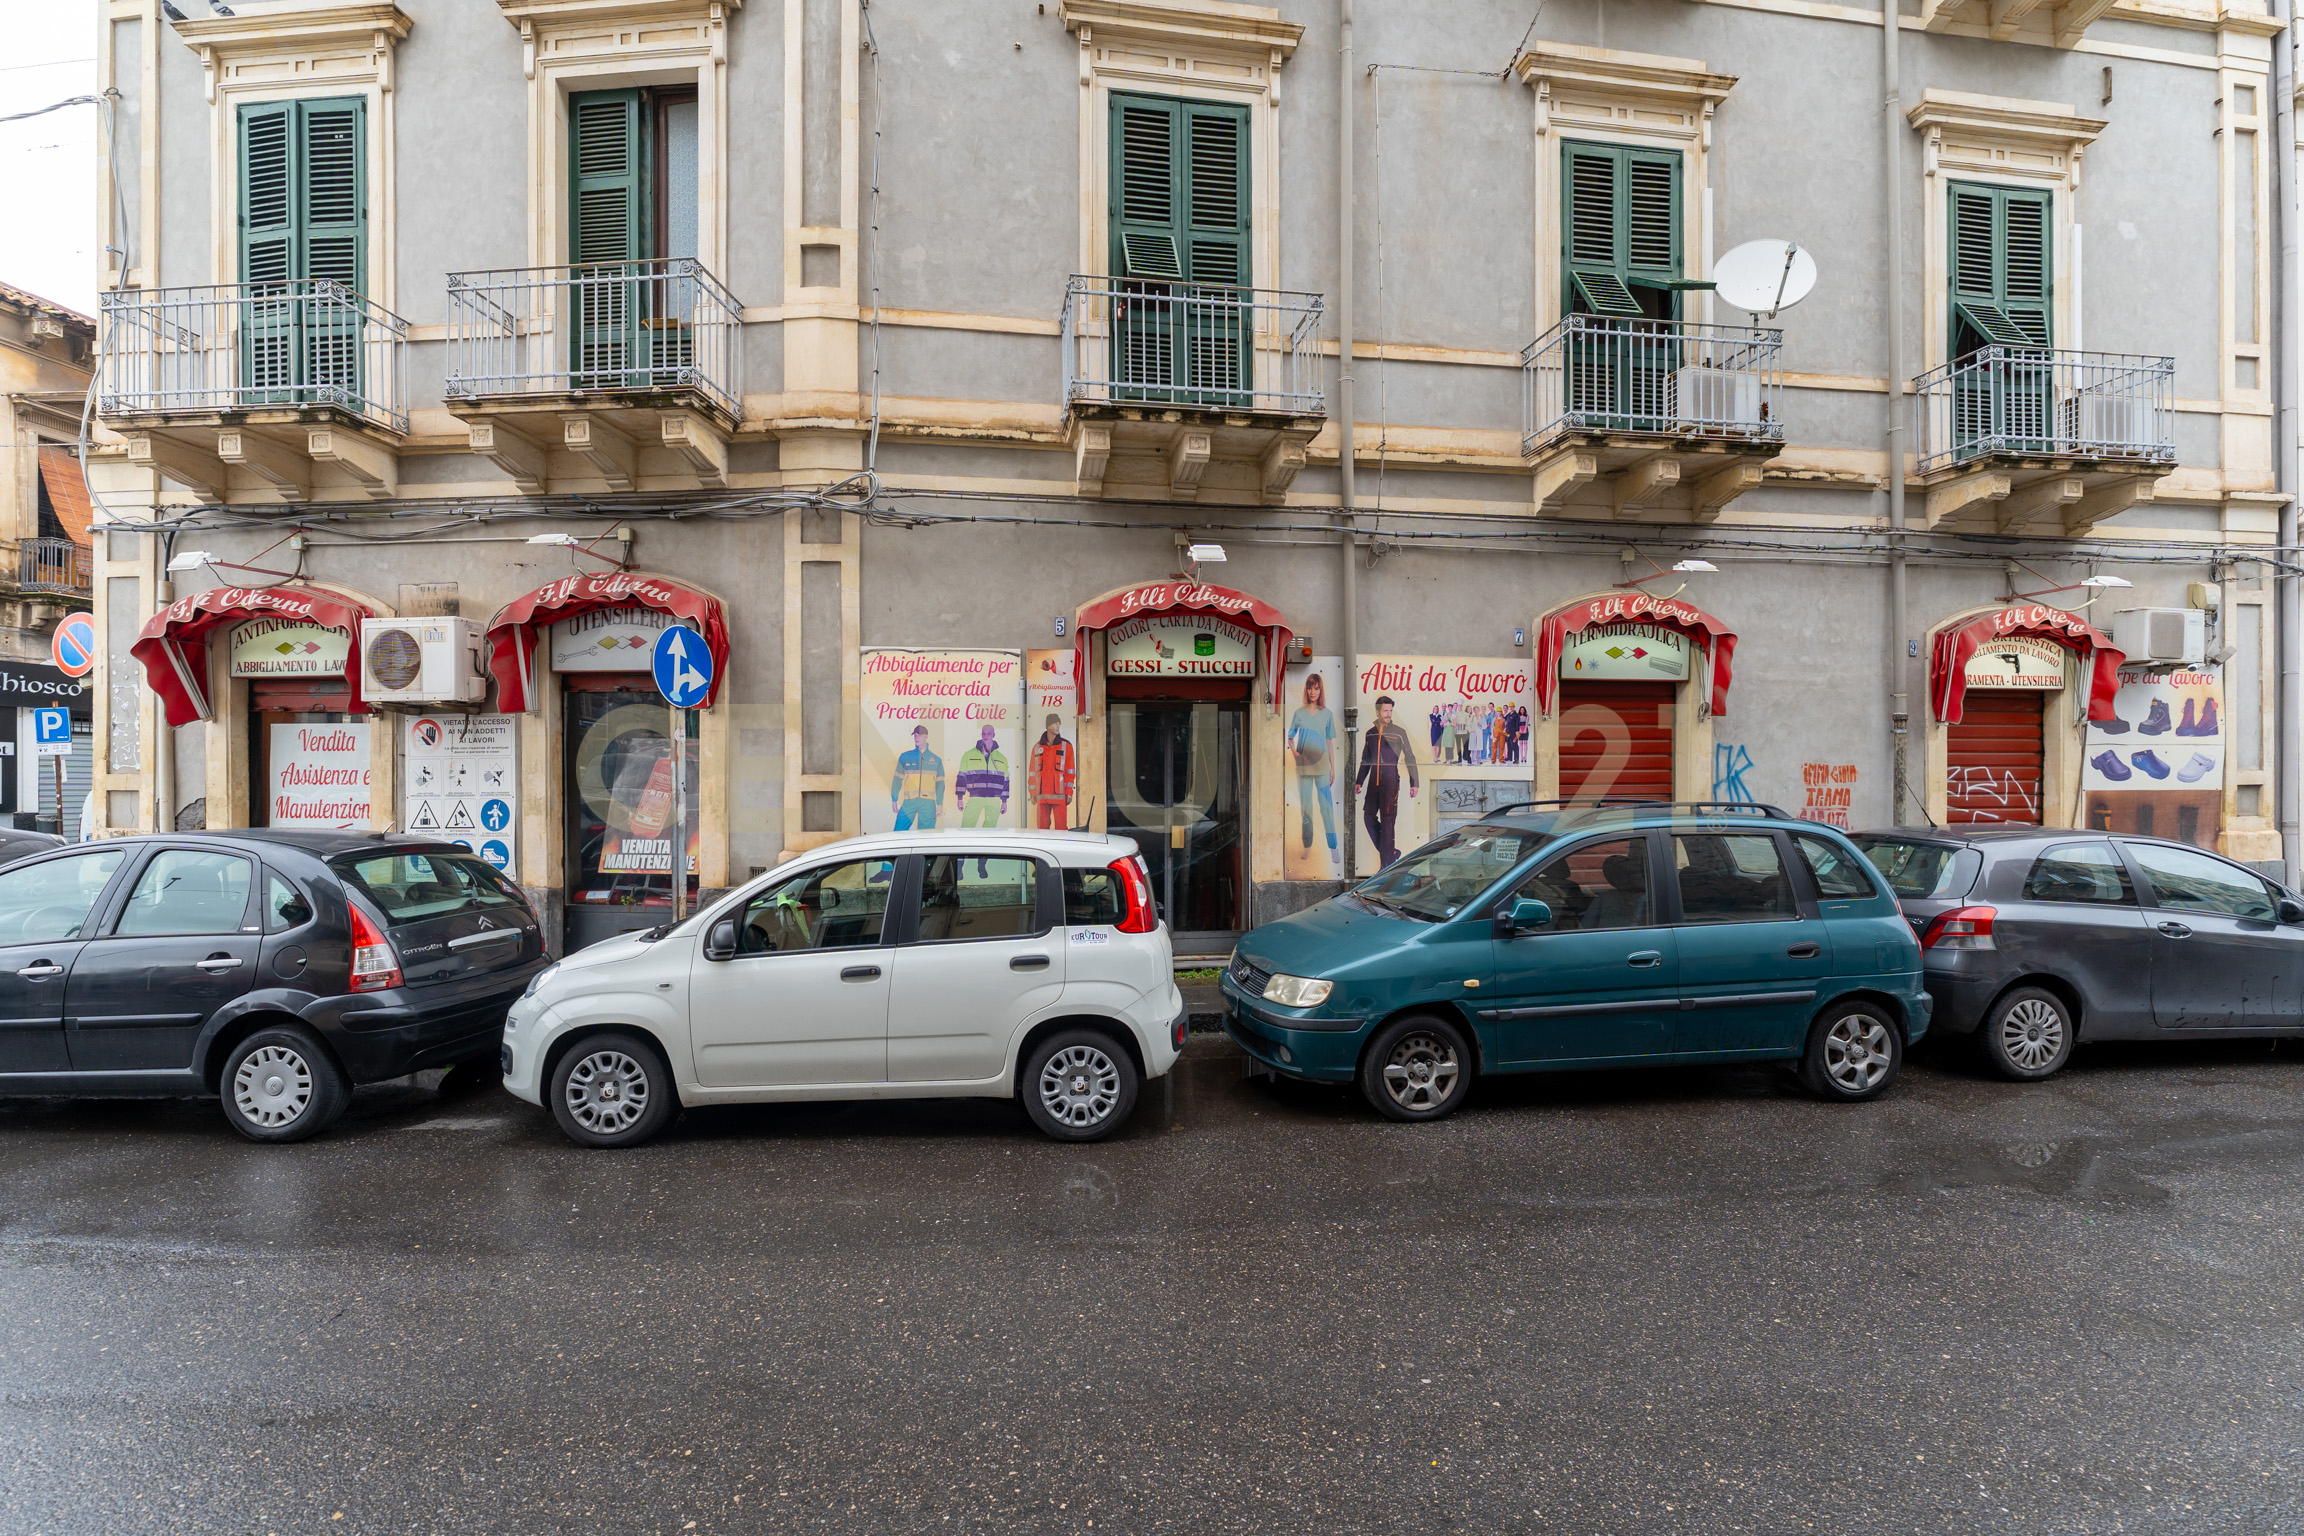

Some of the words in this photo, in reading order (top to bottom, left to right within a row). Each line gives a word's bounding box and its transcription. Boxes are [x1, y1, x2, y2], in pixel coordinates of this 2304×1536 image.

[588, 575, 671, 602] Odierno
[1121, 587, 1166, 613] F.lli
[1174, 584, 1254, 611] Odierno
[221, 588, 312, 614] Odierno
[1631, 595, 1700, 622] Odierno
[569, 607, 677, 636] UTENSILERIA
[1056, 619, 1064, 632] 5
[1110, 618, 1151, 646] COLORI
[1159, 615, 1195, 628] CARTA
[1196, 615, 1212, 630] DA
[1214, 620, 1253, 648] PARATI
[1516, 630, 1523, 644] 7
[1569, 624, 1681, 653] TERMOIDRAULICA
[1910, 642, 1916, 653] 9
[235, 660, 317, 673] ABBIGLIAMENTO
[867, 655, 985, 678] Abbigliamento
[987, 661, 1014, 678] per
[1110, 659, 1162, 674] GESSI
[1178, 660, 1252, 674] STUCCHI
[2019, 645, 2030, 656] DA
[2031, 648, 2060, 668] LAVORO
[0, 671, 83, 697] hiosco
[892, 678, 991, 697] Misericordia
[1028, 683, 1075, 691] Abbigliamento
[1360, 662, 1414, 695] Abiti
[1418, 665, 1447, 692] da
[1455, 664, 1528, 700] Lavoro
[2011, 675, 2063, 687] UTENSILERIA
[2169, 672, 2215, 689] Lavoro
[876, 701, 960, 720] Protezione
[965, 702, 1007, 720] Civile
[1041, 695, 1063, 707] 118
[41, 711, 63, 740] P
[472, 718, 511, 726] L'ACCESSO
[297, 728, 356, 752] Vendita
[280, 762, 359, 788] Assistenza
[621, 839, 671, 854] VENDITA
